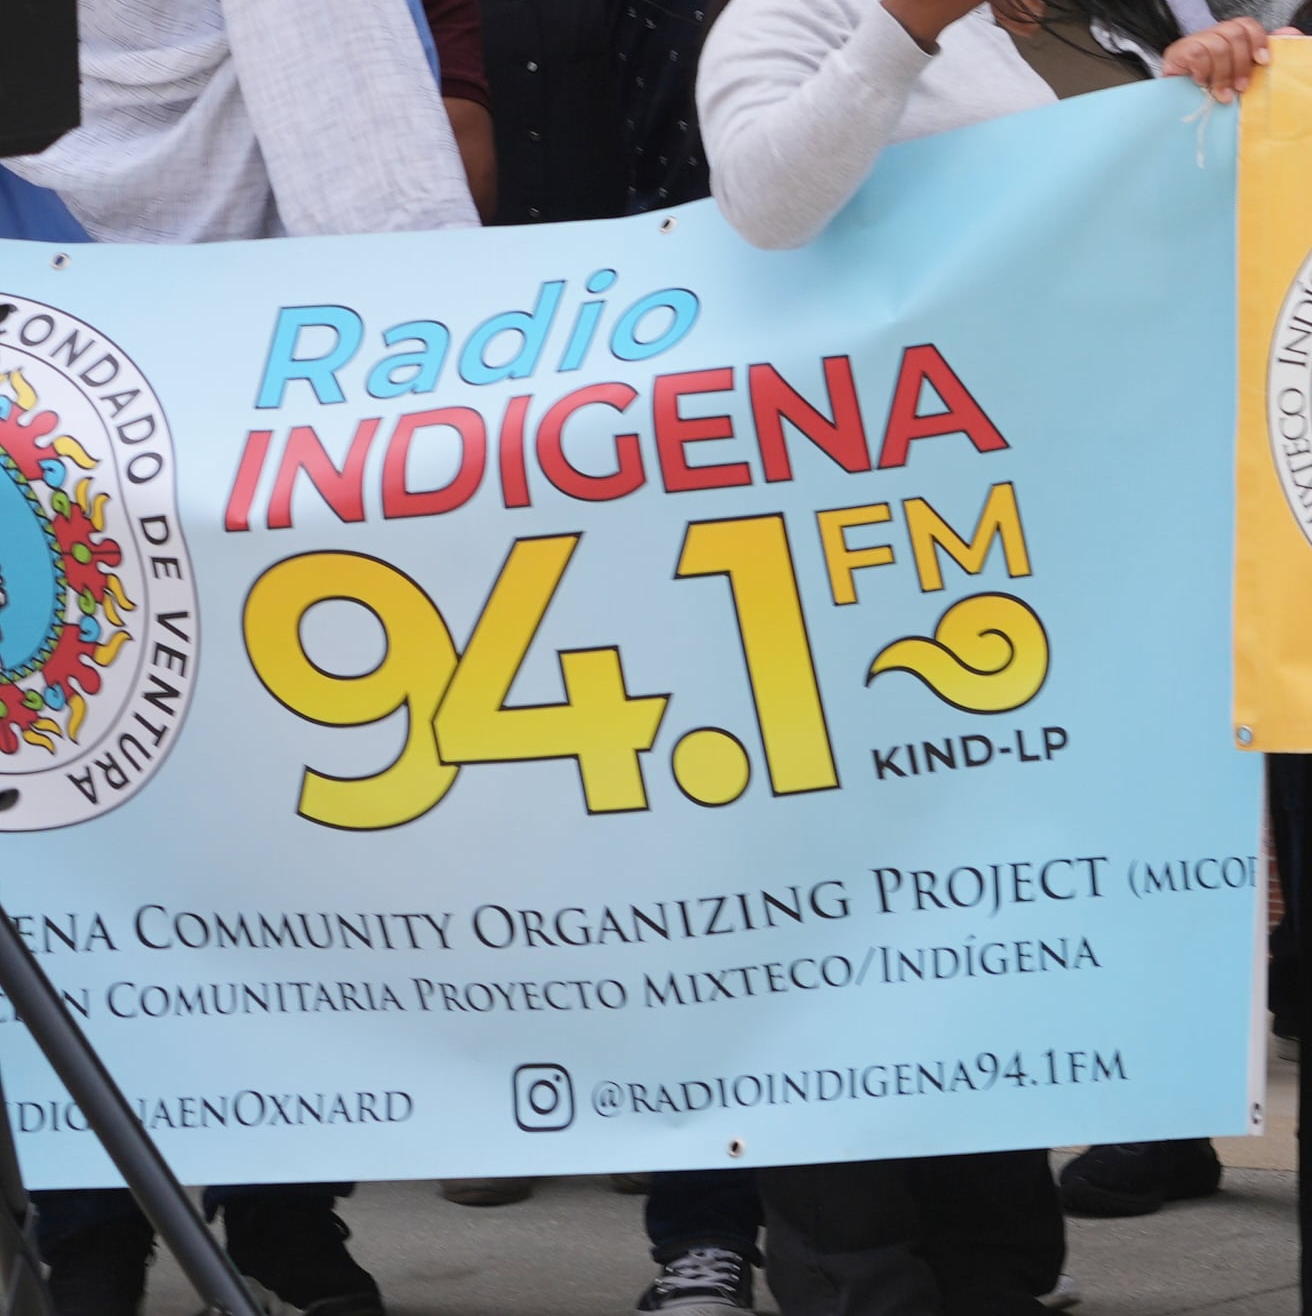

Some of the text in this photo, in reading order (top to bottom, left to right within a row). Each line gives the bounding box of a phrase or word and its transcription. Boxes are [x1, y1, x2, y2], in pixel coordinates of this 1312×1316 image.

[254, 268, 699, 411] Radio
[222, 342, 1012, 532] INDIGENA
[0, 304, 191, 807] ONDADO DE VENTURA
[241, 480, 1034, 832] 94.1 FM
[871, 725, 1072, 781] KIND-LP
[133, 903, 455, 952] COMMUNITY
[472, 879, 853, 951] ORGANIZING
[871, 855, 1110, 918] PROJECT
[104, 977, 406, 1020] COMUNITARIA
[416, 976, 629, 1014] PROYECTO
[643, 933, 1103, 1011] MIXTECO/INDÍGENA
